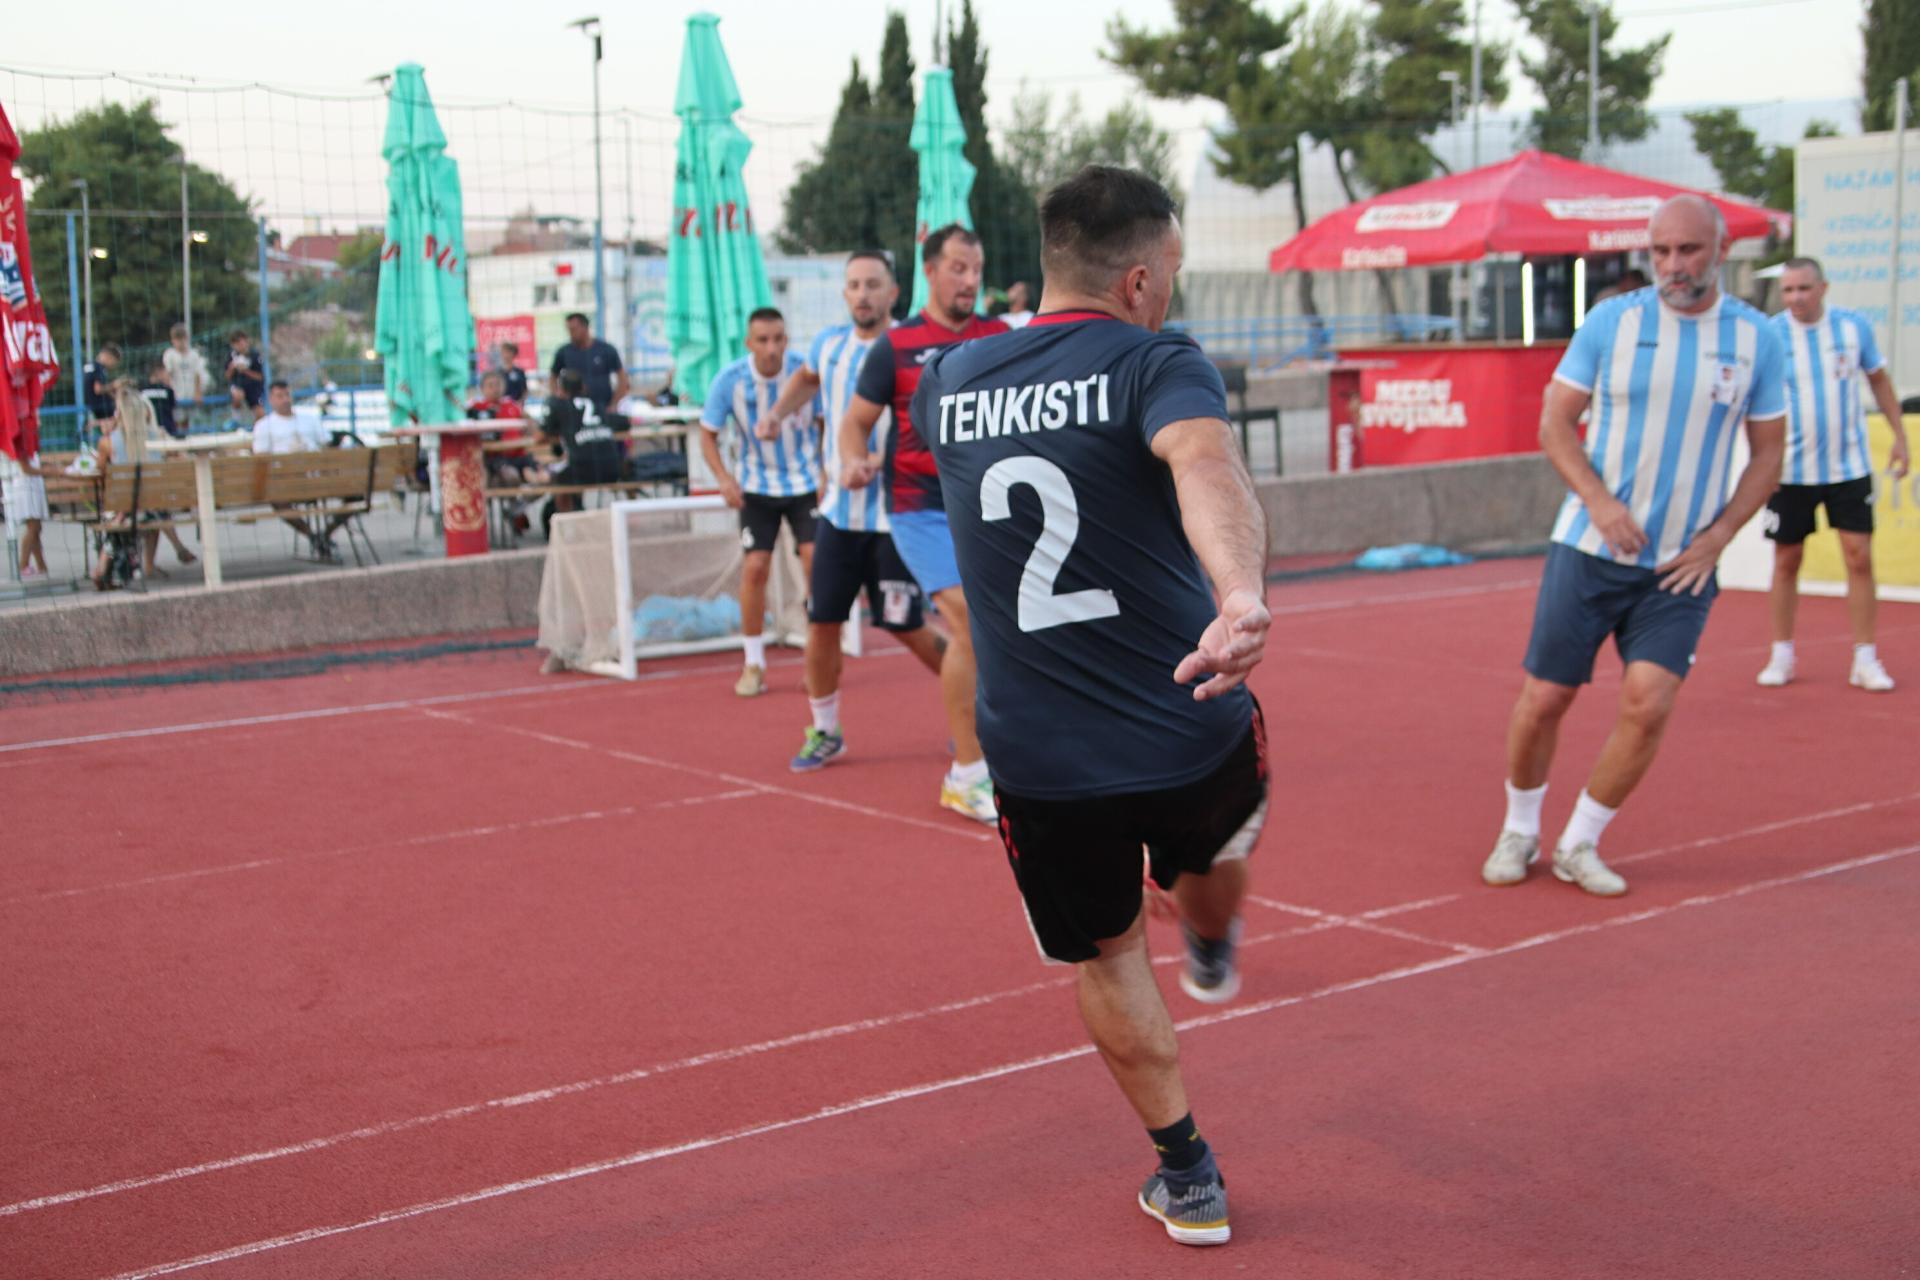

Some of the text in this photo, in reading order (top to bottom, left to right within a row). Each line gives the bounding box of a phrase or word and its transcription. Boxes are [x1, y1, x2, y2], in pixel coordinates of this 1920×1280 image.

[573, 397, 601, 426] 2
[939, 374, 1109, 444] TENKISTI
[980, 455, 1120, 632] 2
